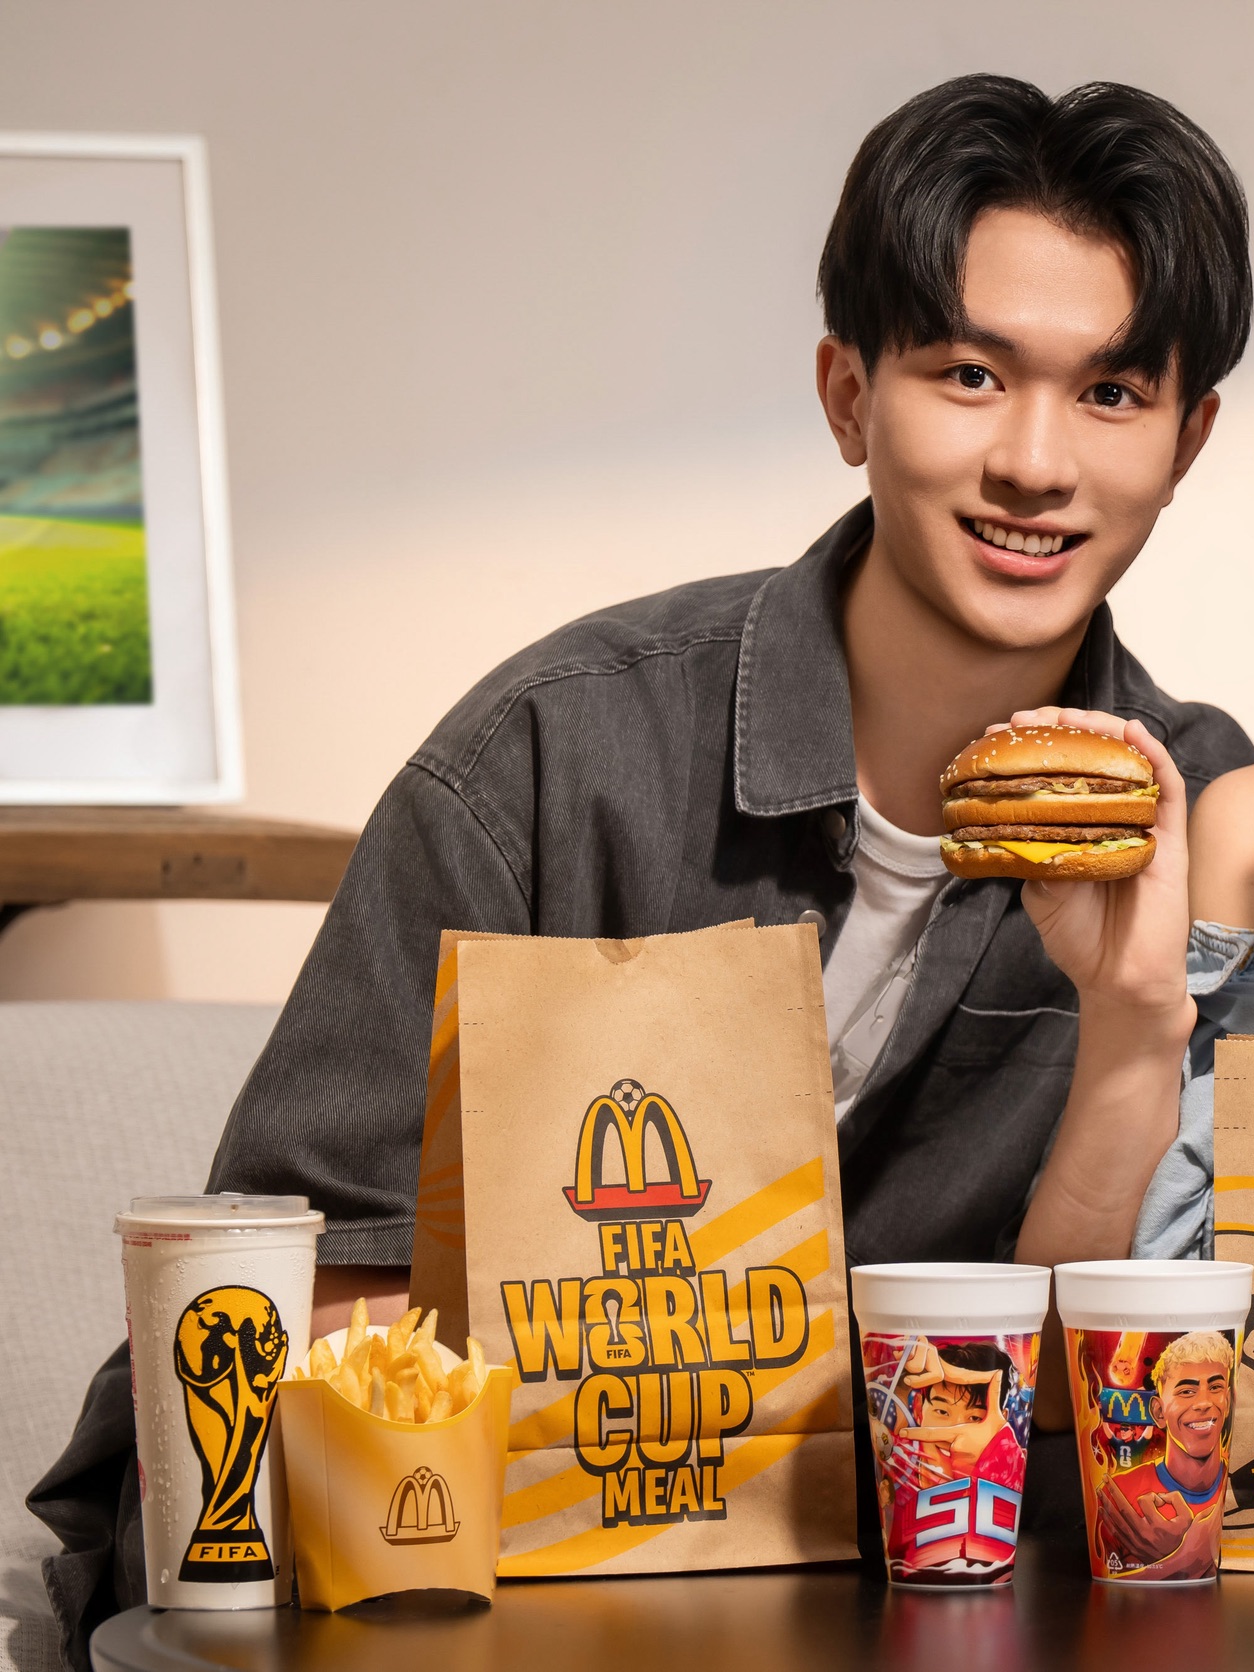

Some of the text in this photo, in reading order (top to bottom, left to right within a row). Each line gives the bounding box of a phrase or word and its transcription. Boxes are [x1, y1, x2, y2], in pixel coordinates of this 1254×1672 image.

[598, 1219, 696, 1277] FIFA
[606, 1348, 632, 1359] FIFA
[602, 1464, 727, 1528] MEAL
[199, 1545, 258, 1559] FIFA
